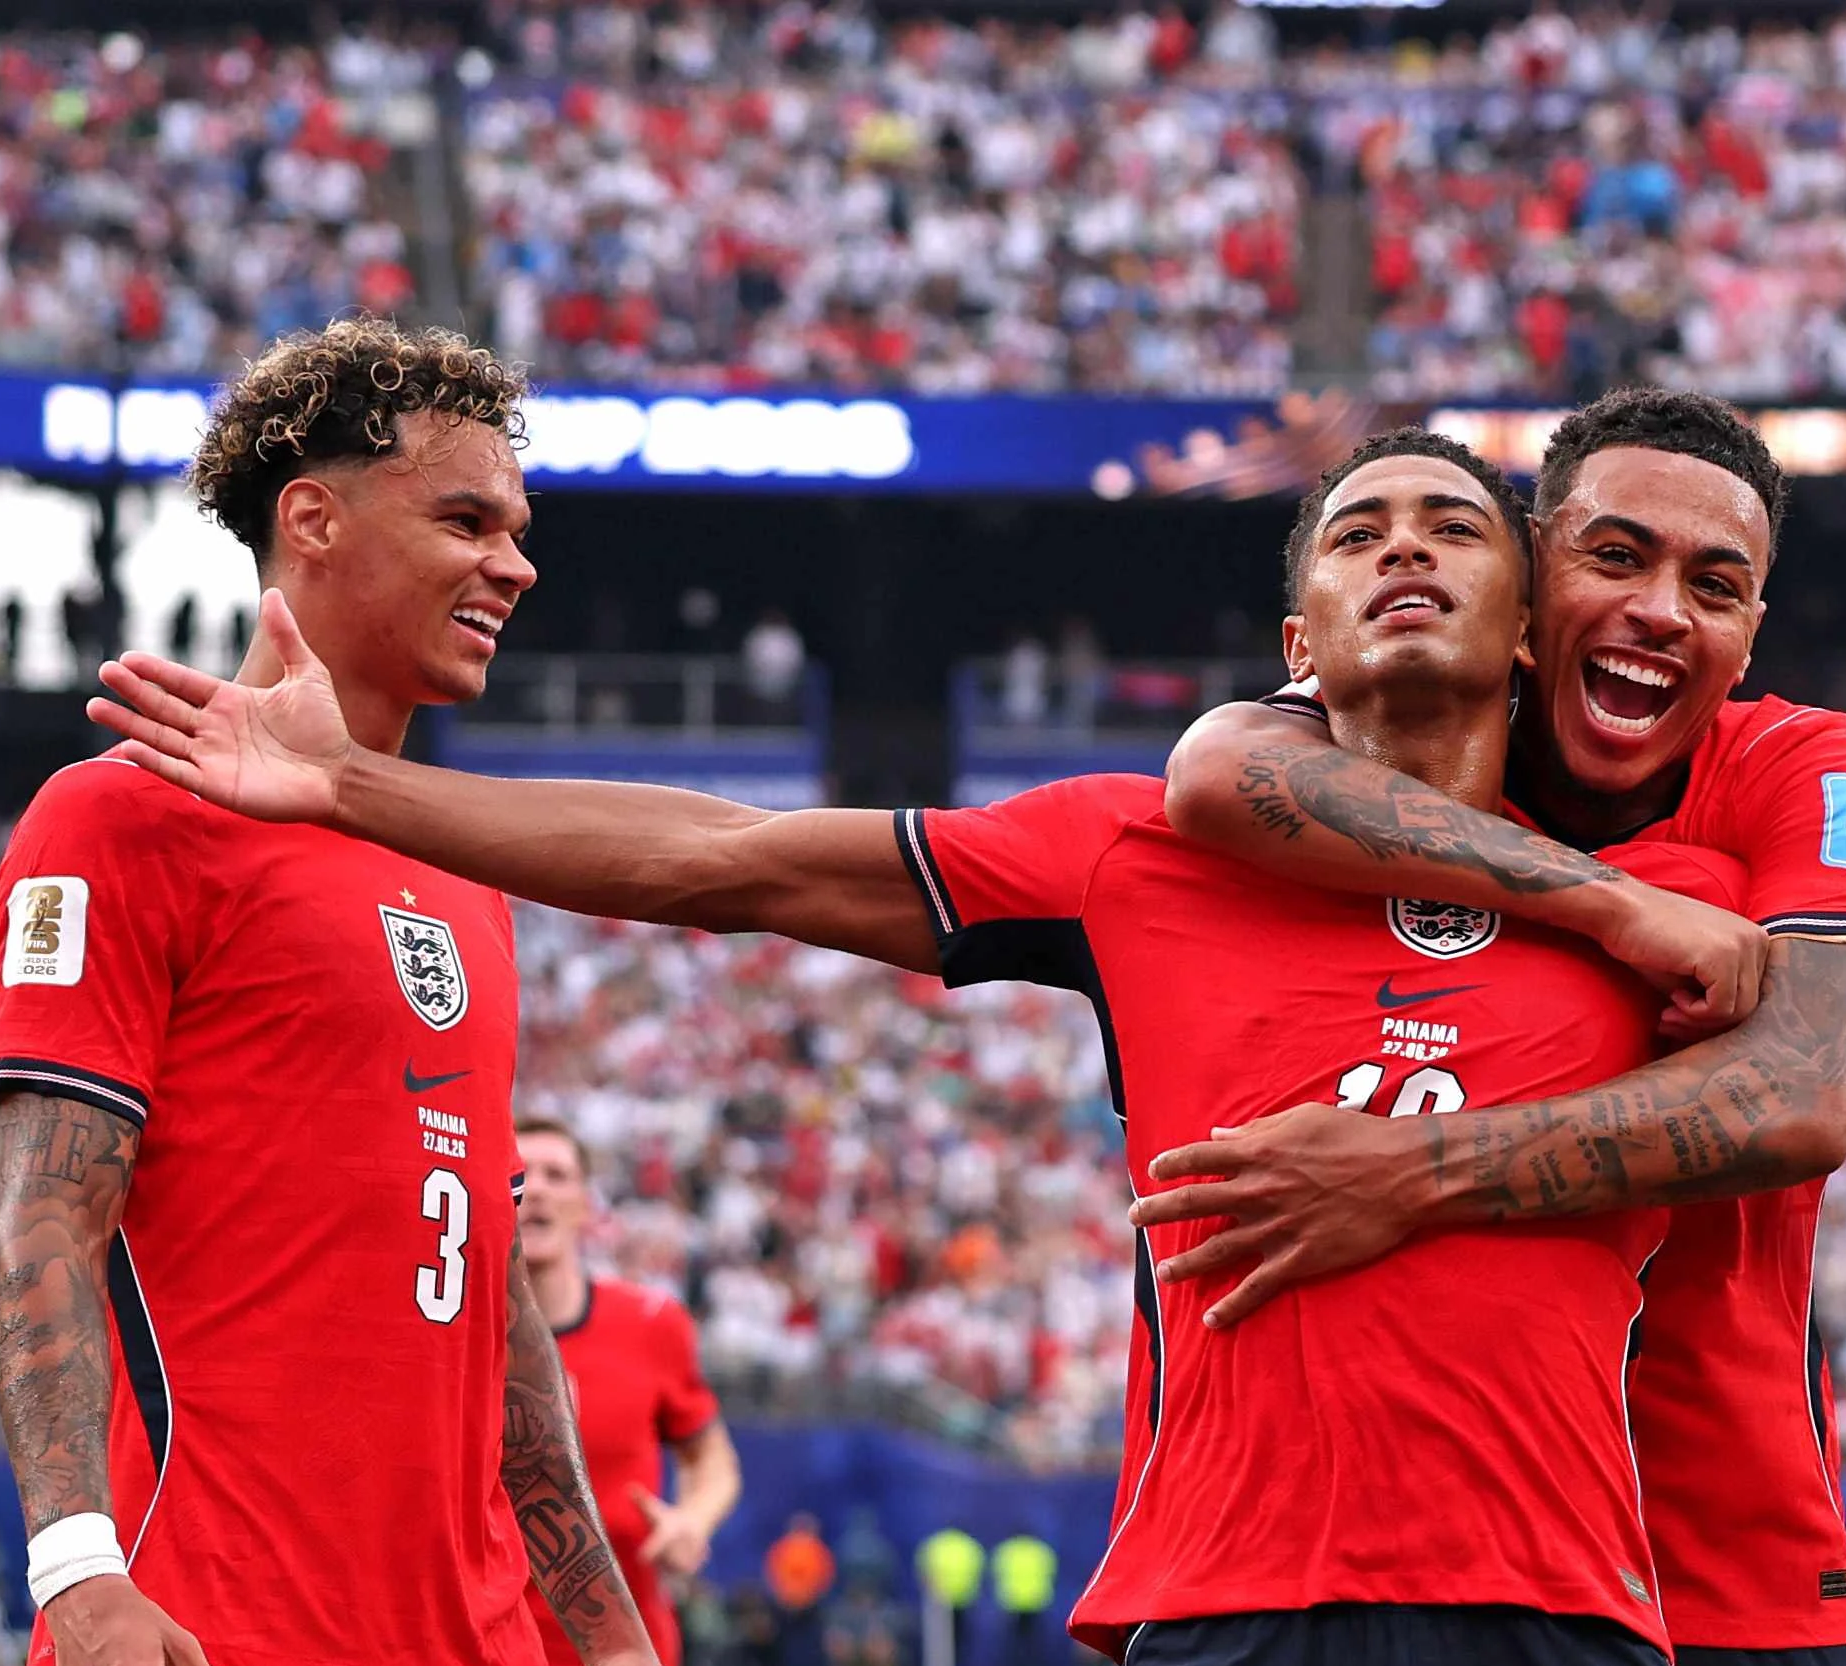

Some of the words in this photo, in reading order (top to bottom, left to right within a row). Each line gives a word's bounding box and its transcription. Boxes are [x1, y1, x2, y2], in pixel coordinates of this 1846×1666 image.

[1380, 1017, 1458, 1044] PANAMA
[417, 1105, 469, 1137] PANAMA
[422, 1130, 466, 1159] 27.06.26
[414, 1167, 471, 1325] 3
